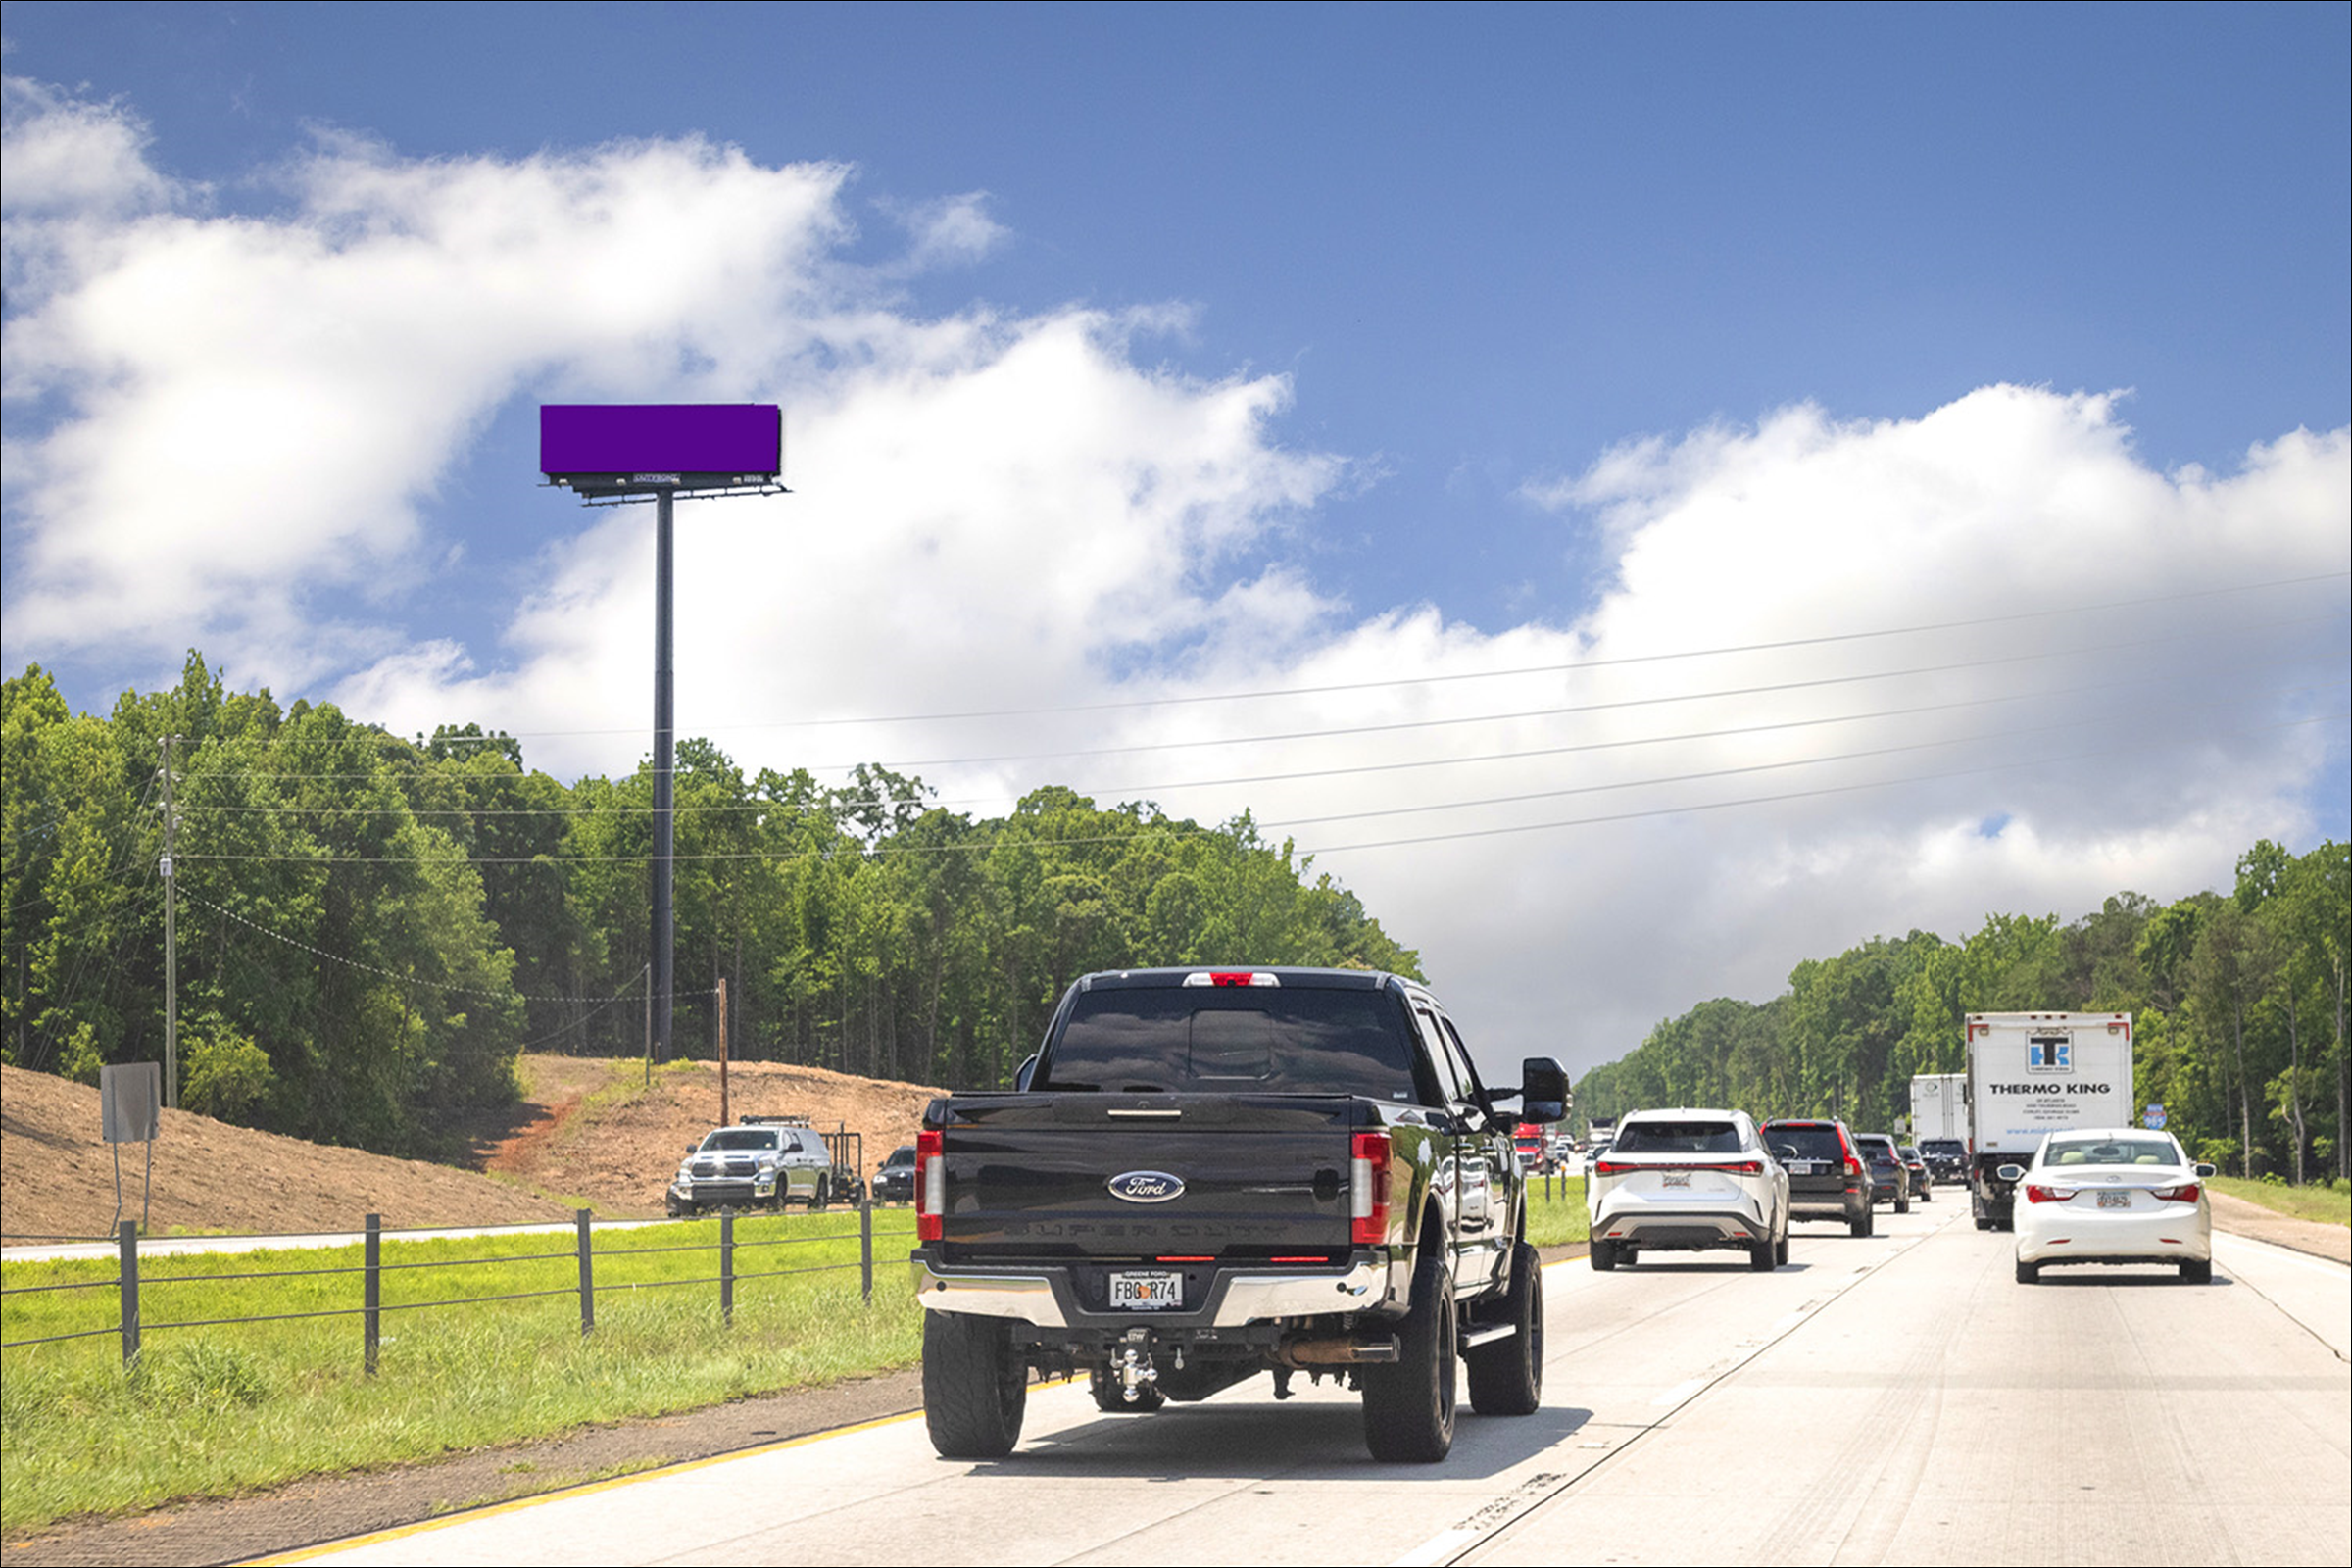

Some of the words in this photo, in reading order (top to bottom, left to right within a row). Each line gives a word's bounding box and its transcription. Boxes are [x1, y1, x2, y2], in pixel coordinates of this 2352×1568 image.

[1989, 1083, 2061, 1095] THERMO
[2067, 1083, 2111, 1094] KING
[1125, 1176, 1167, 1195] Ford
